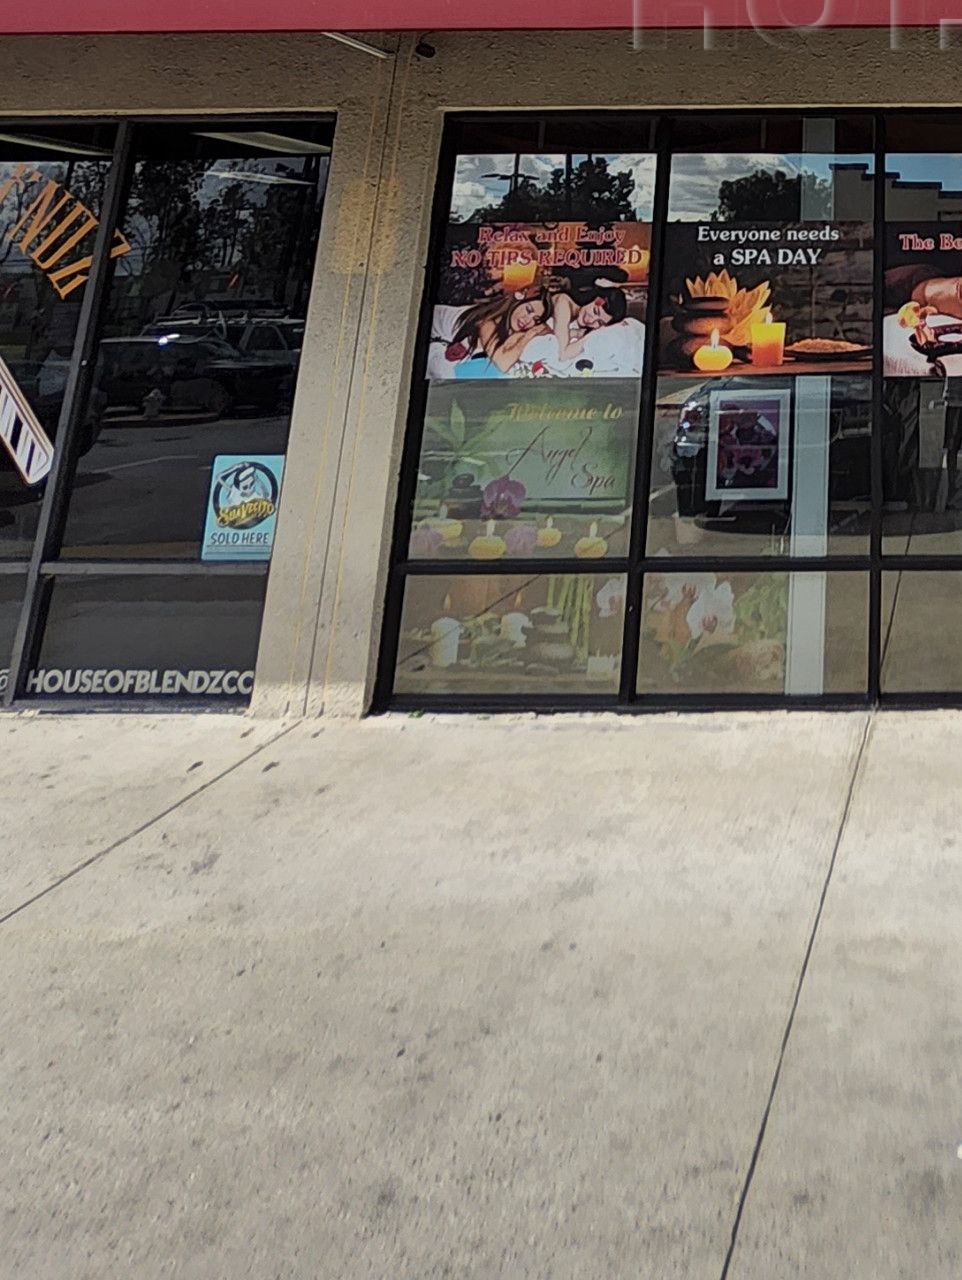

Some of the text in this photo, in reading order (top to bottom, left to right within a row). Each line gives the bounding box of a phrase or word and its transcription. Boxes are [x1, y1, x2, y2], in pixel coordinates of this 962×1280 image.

[477, 225, 627, 245] Relax and Enjoy
[697, 225, 840, 244] Everyone needs
[898, 232, 936, 251] The
[450, 248, 643, 268] NO TIPS REQUIRED
[713, 248, 822, 265] a SPA DAY
[571, 462, 616, 496] Spa
[210, 532, 270, 544] SOLD HERE
